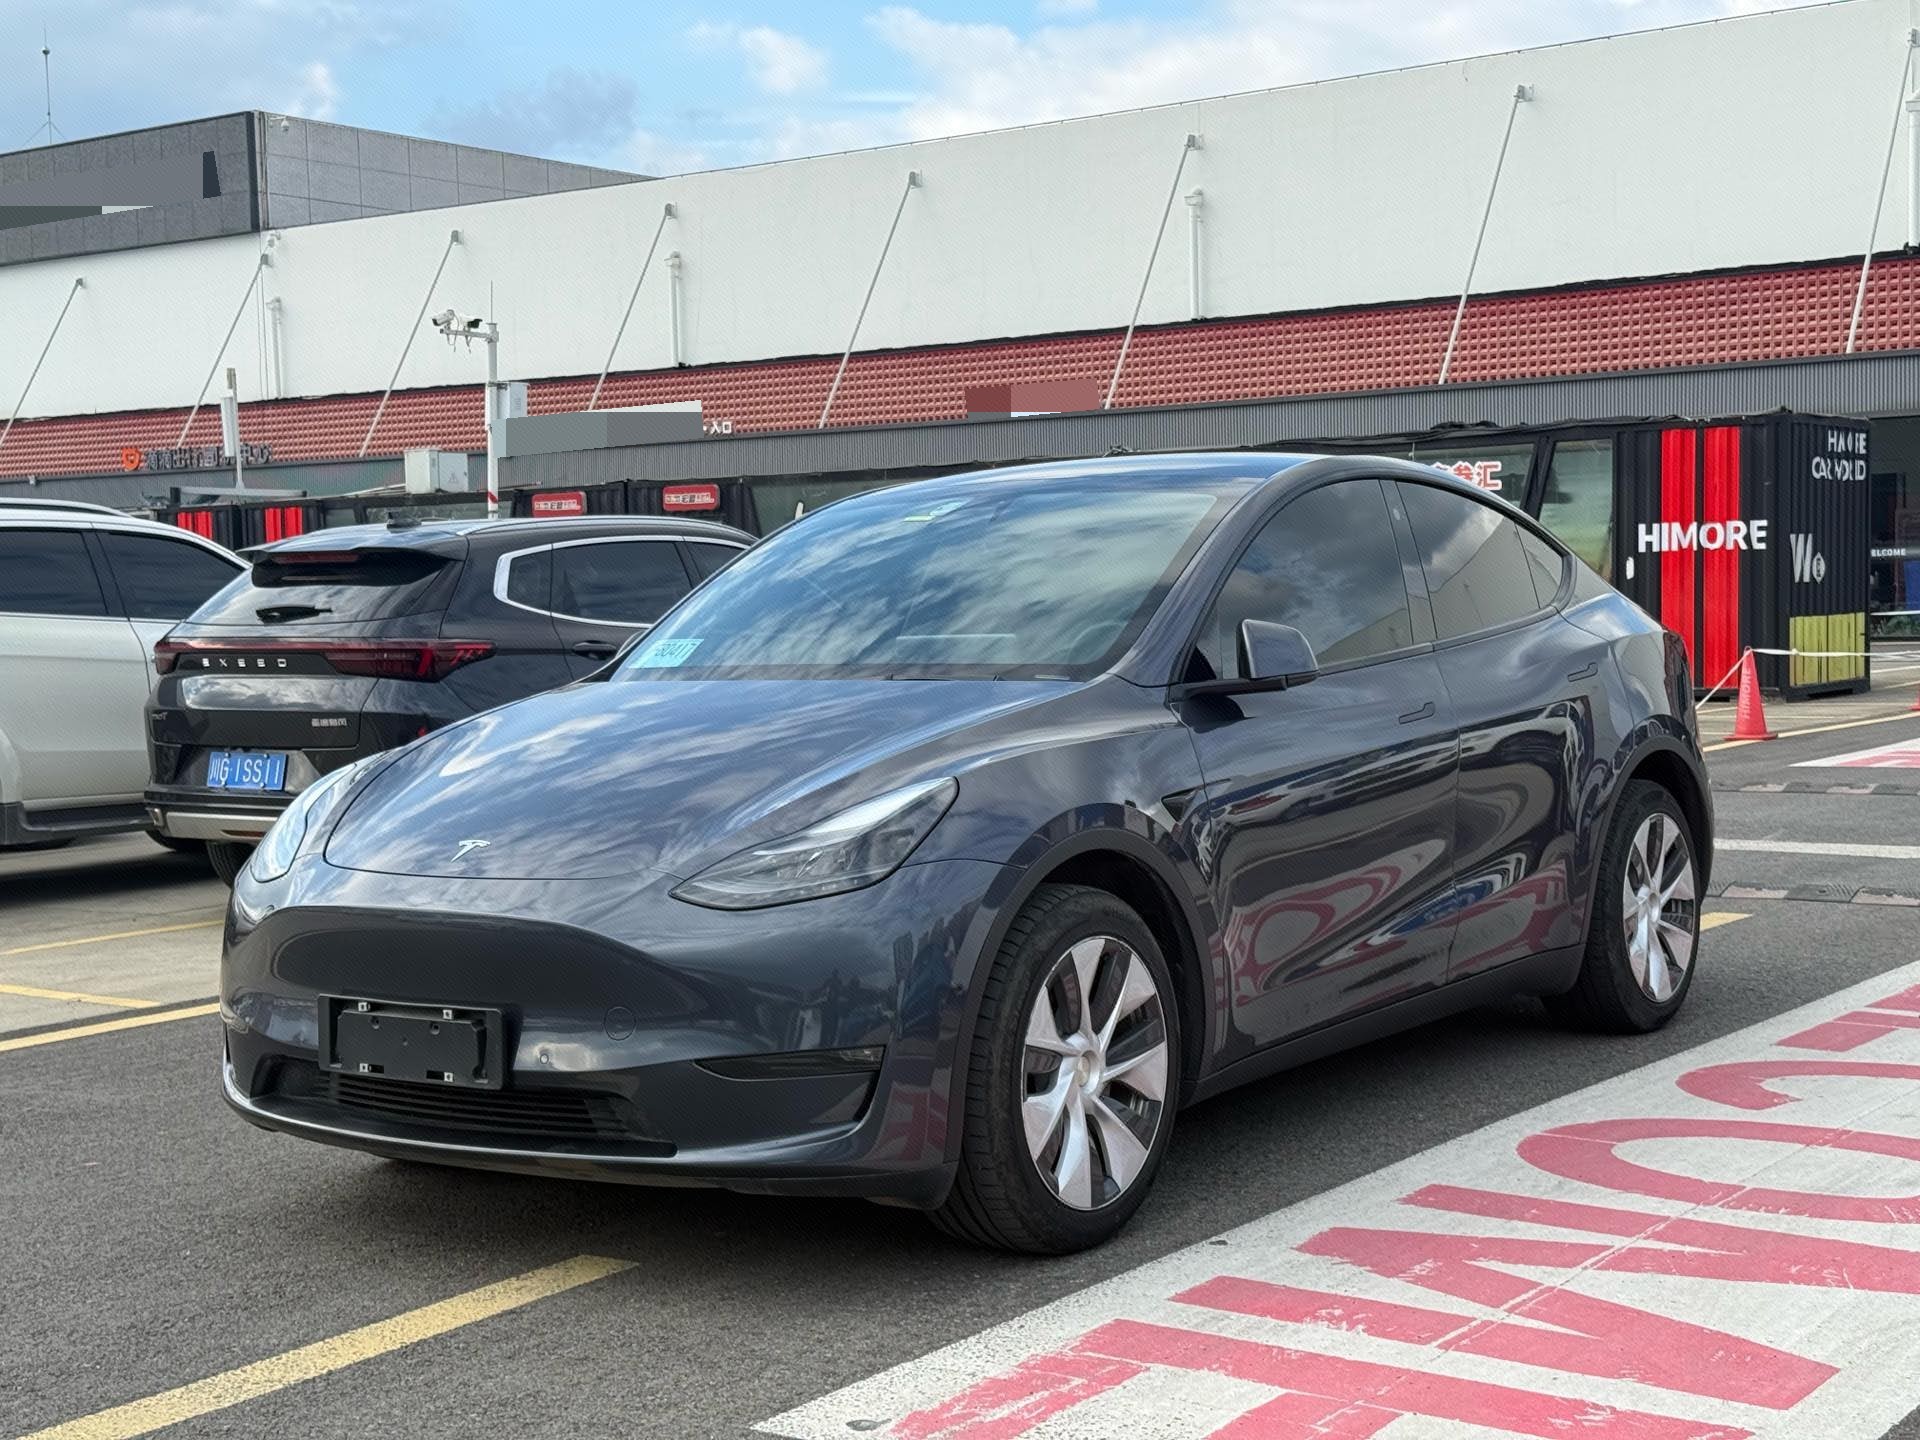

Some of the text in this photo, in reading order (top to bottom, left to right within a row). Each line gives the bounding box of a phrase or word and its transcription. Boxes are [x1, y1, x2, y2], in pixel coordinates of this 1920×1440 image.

[710, 421, 732, 434] 入口
[1638, 519, 1768, 553] HIMORE
[202, 657, 287, 668] EXEED
